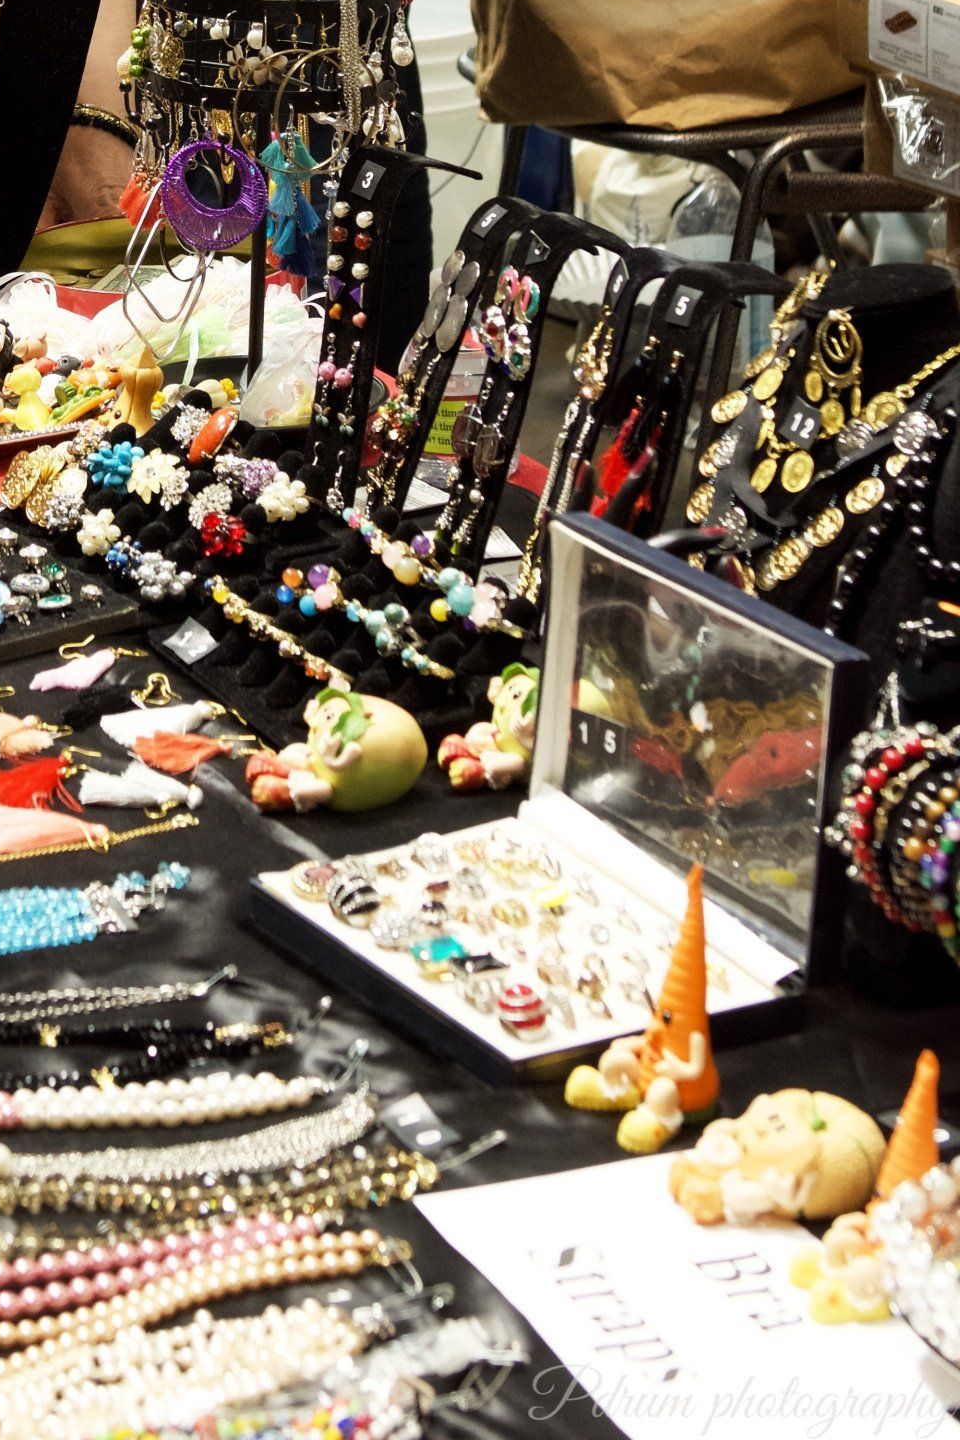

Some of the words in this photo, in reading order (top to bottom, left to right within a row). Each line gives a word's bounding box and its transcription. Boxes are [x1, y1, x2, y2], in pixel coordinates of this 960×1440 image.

[361, 171, 374, 189] 3
[481, 212, 497, 228] 5
[612, 274, 624, 293] 5
[675, 296, 690, 316] 5
[790, 412, 816, 439] 12
[695, 1251, 803, 1331] Bra
[527, 1246, 698, 1384] Straps
